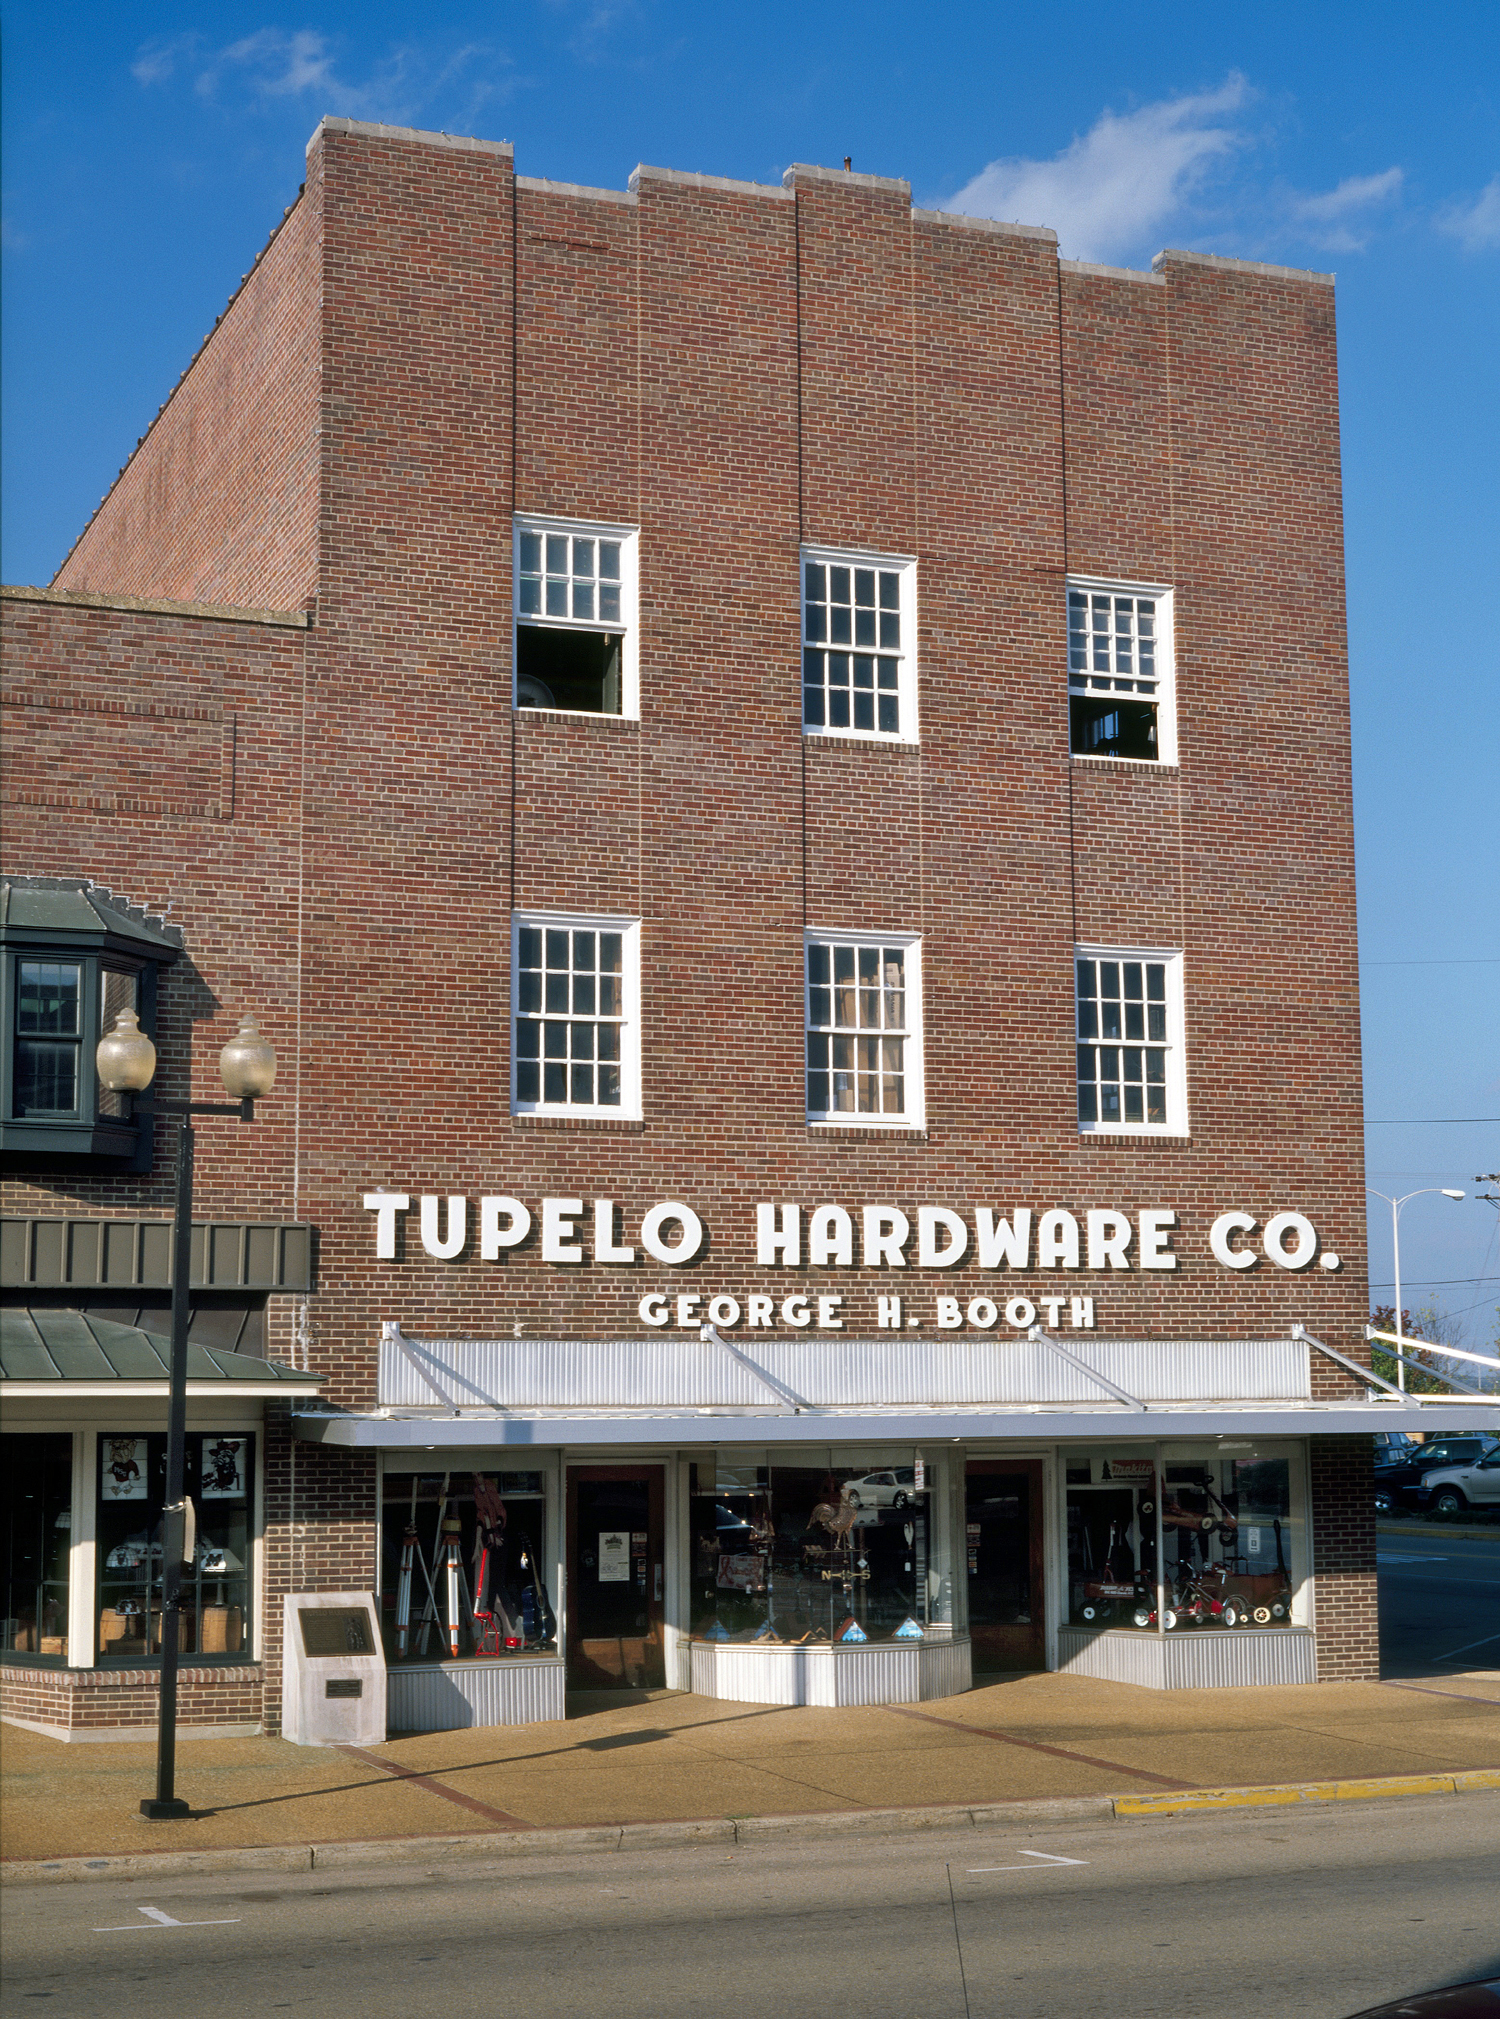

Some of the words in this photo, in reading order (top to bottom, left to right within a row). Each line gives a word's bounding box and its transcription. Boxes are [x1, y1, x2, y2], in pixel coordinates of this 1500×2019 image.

[362, 1192, 703, 1265] TUPELO
[755, 1202, 1177, 1270] HARDWARE
[1208, 1210, 1340, 1271] CO.
[637, 1292, 844, 1329] GEORGE
[876, 1295, 920, 1329] H.
[935, 1296, 1095, 1329] BOOTH
[821, 1570, 831, 1581] N
[861, 1569, 872, 1580] S
